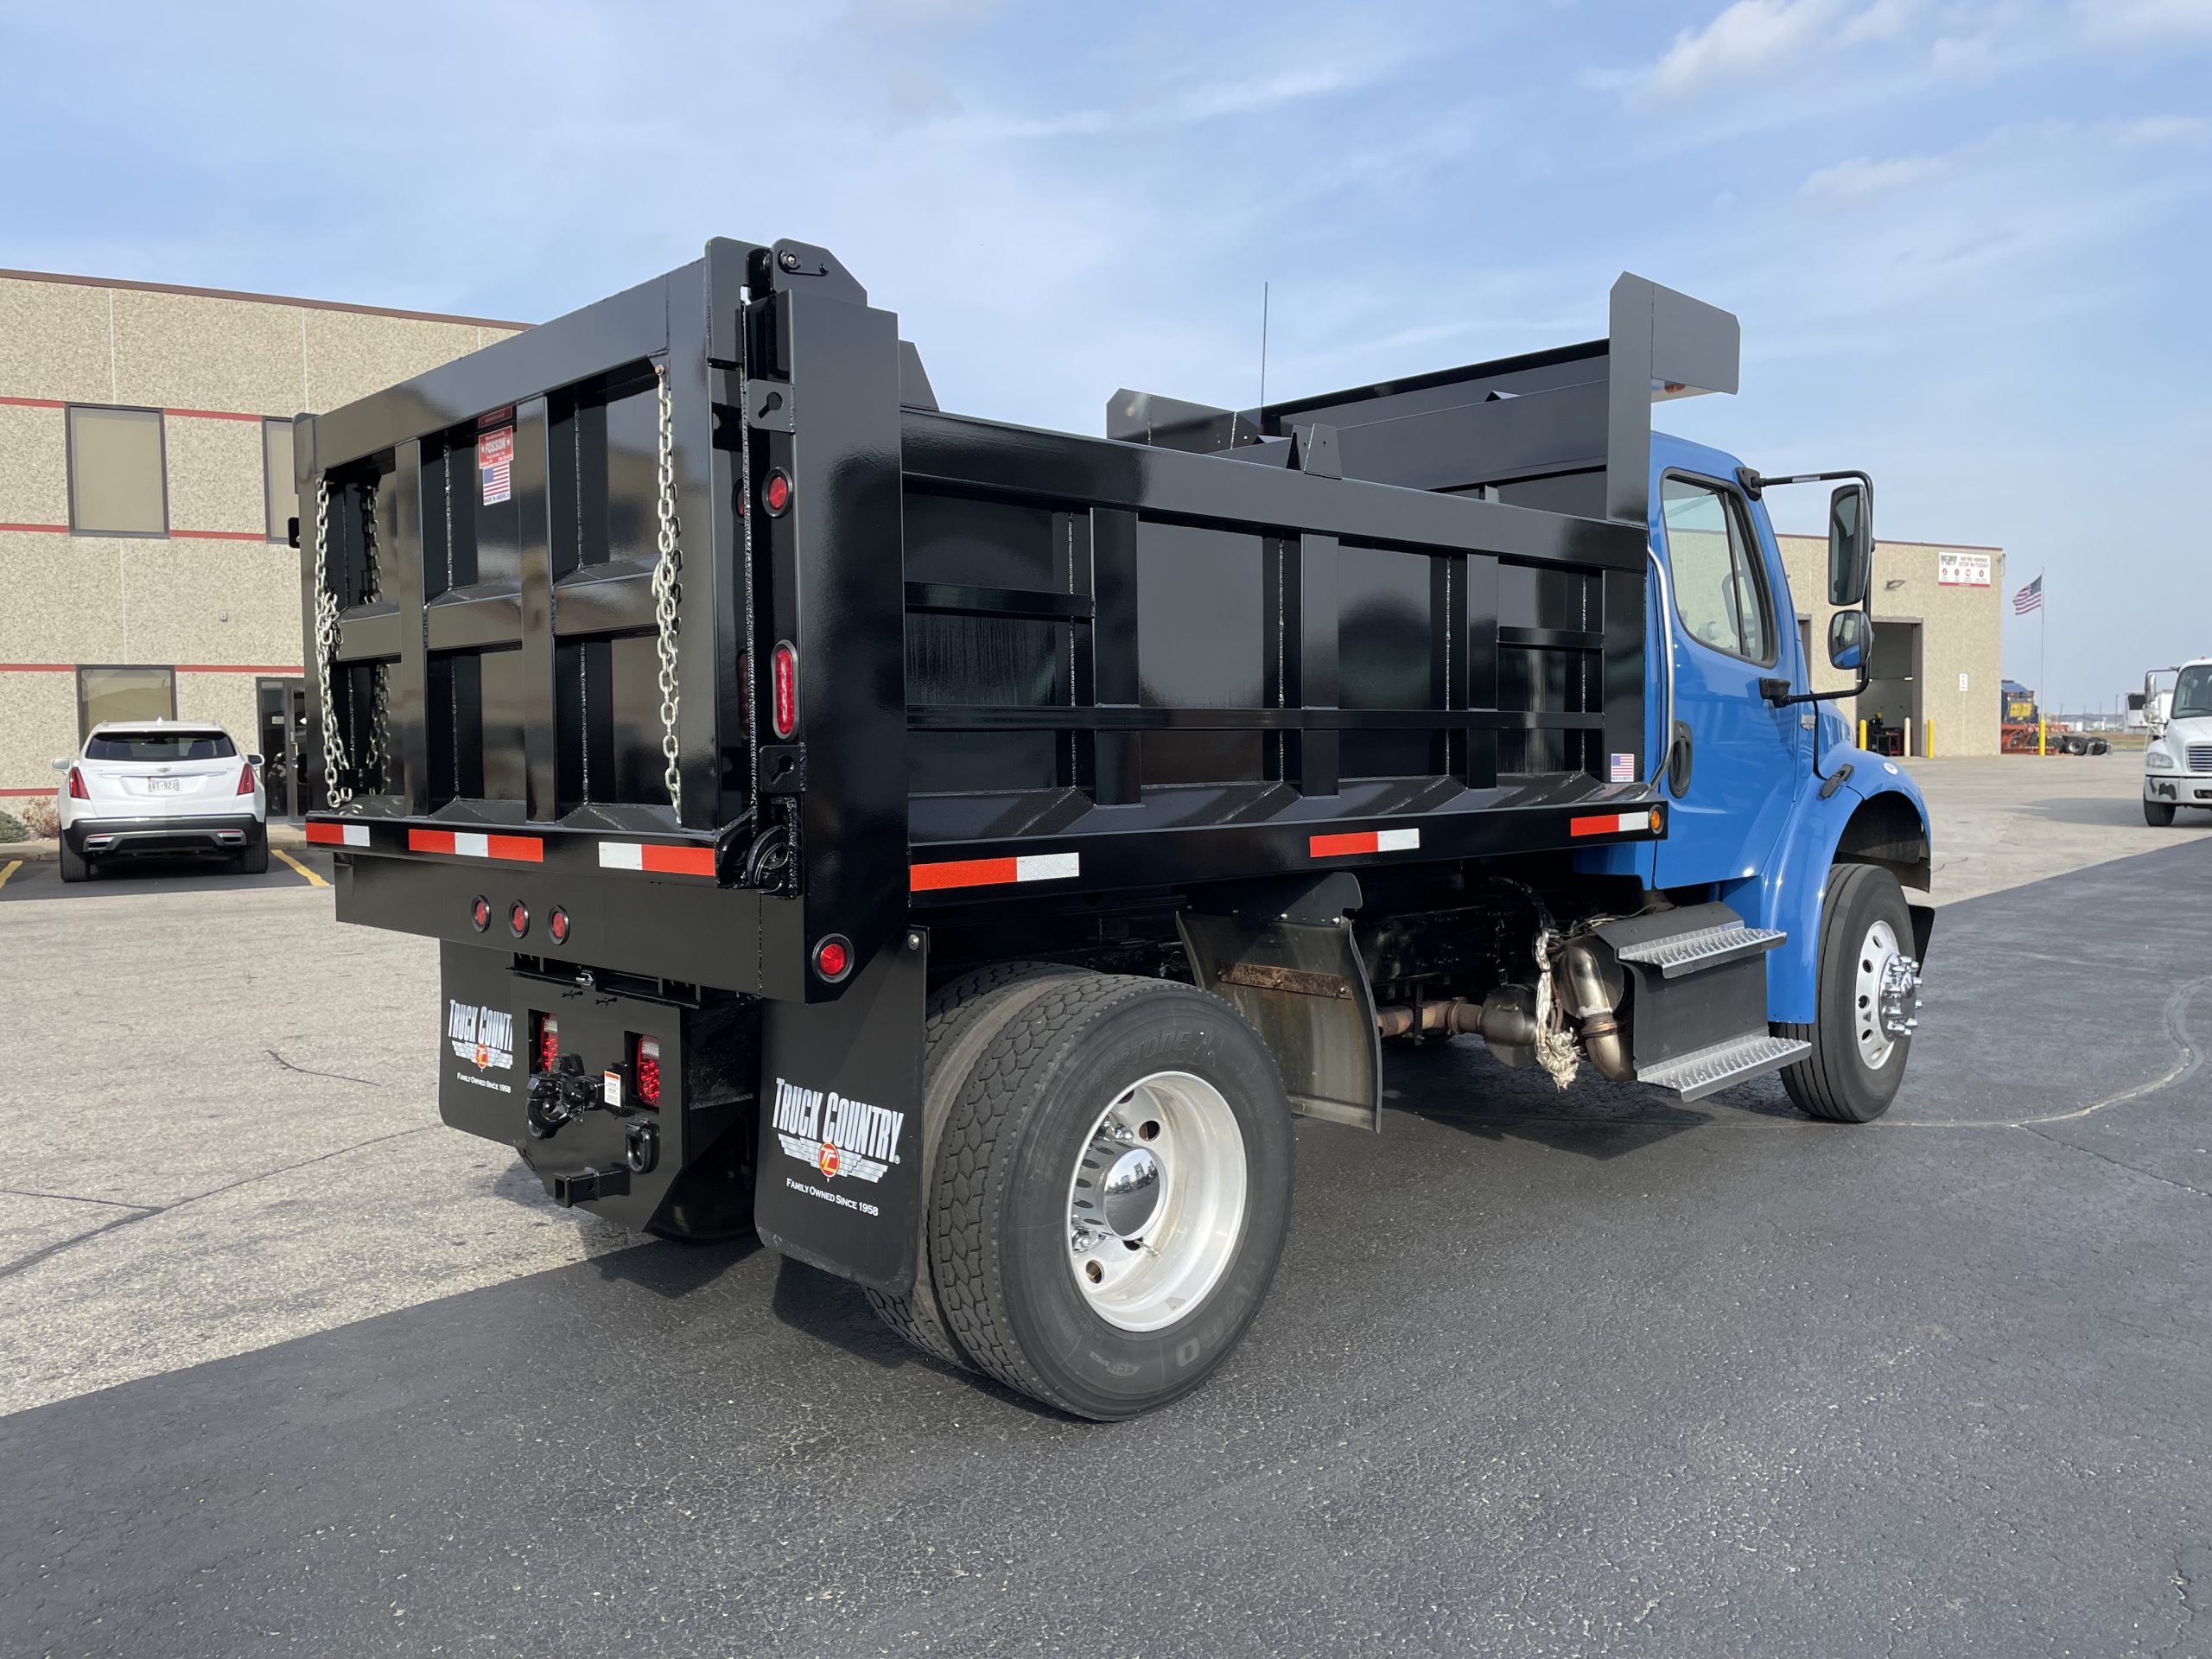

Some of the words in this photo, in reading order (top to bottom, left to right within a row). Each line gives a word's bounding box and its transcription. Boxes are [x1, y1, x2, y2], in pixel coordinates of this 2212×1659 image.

[448, 999, 479, 1043] TRUCK
[478, 1006, 513, 1052] COUNT
[457, 1072, 471, 1083] FAMILY
[470, 1076, 486, 1087] OWNED
[486, 1080, 499, 1090] SINCE
[499, 1084, 512, 1093] 1958
[772, 1077, 823, 1141] TRUCK
[822, 1091, 904, 1163] COUNTRY
[786, 1178, 810, 1193] FAMILY
[810, 1186, 835, 1202] OWNED
[836, 1195, 858, 1211] SINCE
[858, 1202, 879, 1216] 1958
